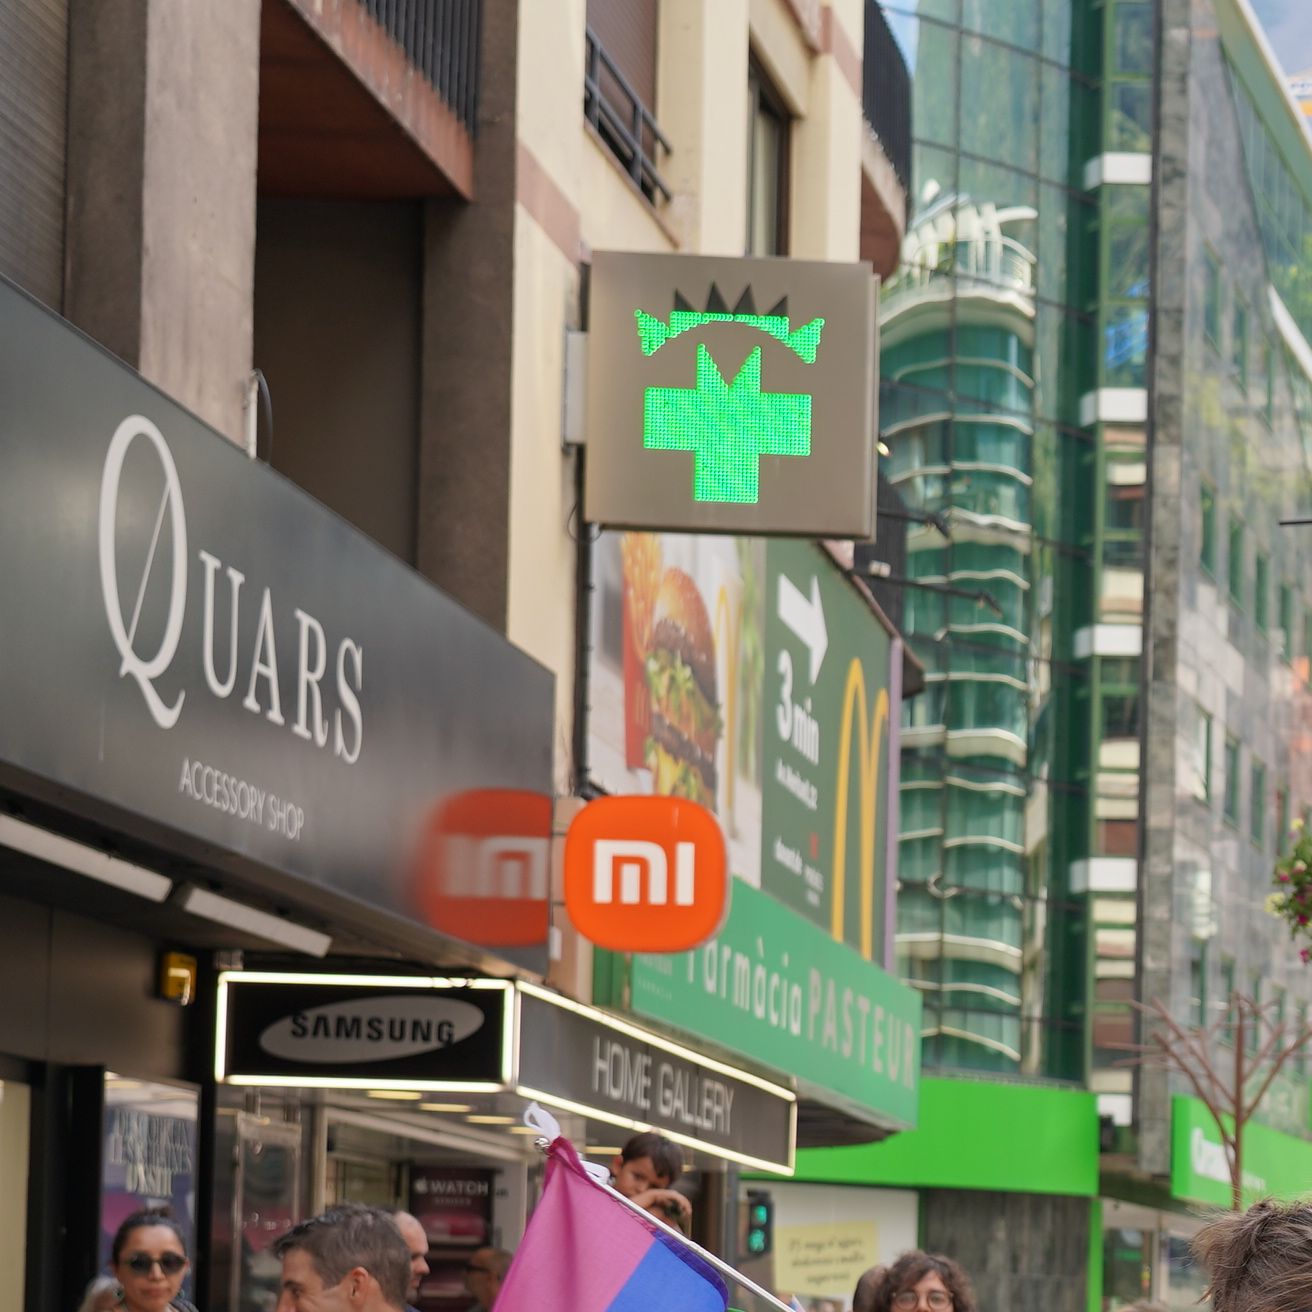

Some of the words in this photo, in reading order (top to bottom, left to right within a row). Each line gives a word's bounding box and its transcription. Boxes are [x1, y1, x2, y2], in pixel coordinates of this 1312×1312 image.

[98, 414, 363, 765] QUARS
[776, 649, 794, 742] 3
[793, 697, 820, 767] min
[179, 756, 266, 824] ACCESSORY
[267, 794, 304, 841] SHOP
[291, 1013, 455, 1047] SAMSUNG
[807, 967, 915, 1091] PASTEUR
[593, 1036, 651, 1111] HOME
[656, 1060, 735, 1138] GALLERY
[431, 1180, 489, 1197] WATCH
